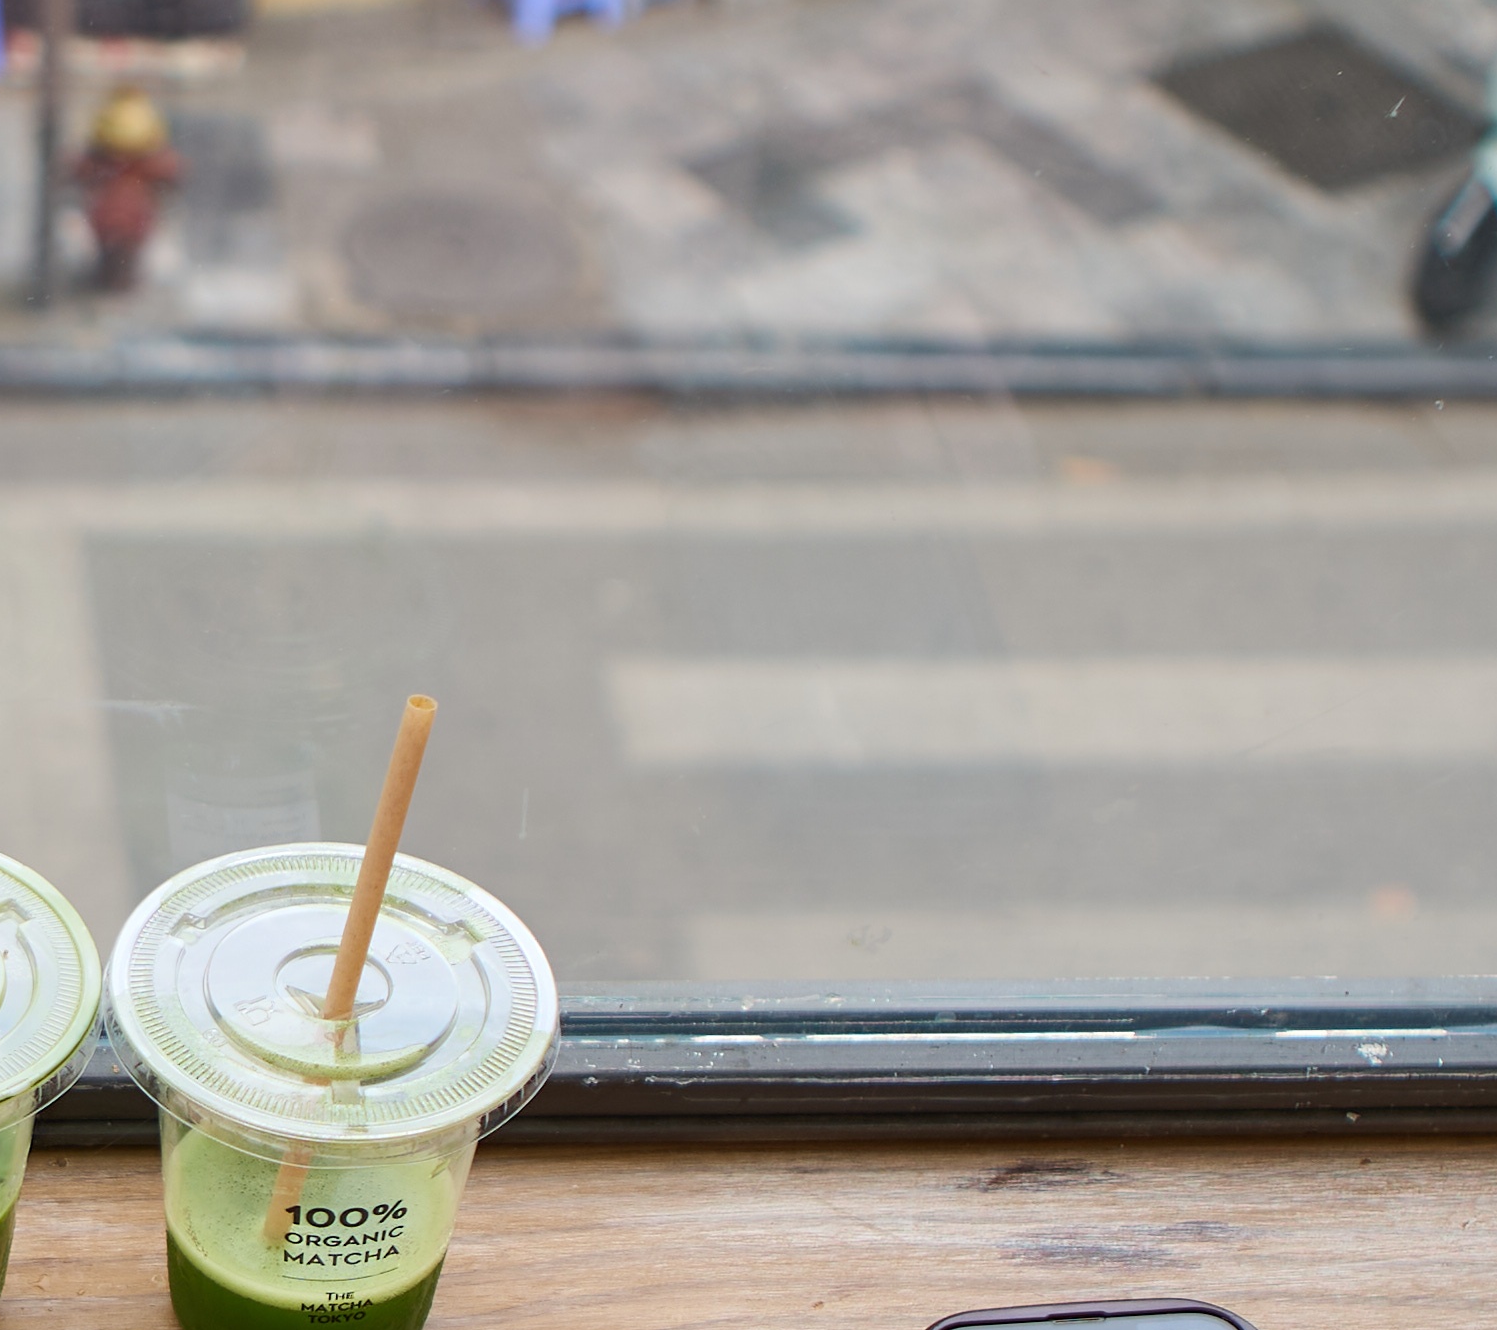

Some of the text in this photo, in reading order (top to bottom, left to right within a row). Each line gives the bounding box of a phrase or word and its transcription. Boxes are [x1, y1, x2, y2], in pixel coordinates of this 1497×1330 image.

[285, 1199, 408, 1228] 100%
[284, 1225, 405, 1247] ORGANIC
[283, 1245, 400, 1267] MATCHA
[325, 1291, 355, 1301] THE
[301, 1298, 374, 1313] MATCHA
[308, 1311, 367, 1324] TOKYO
